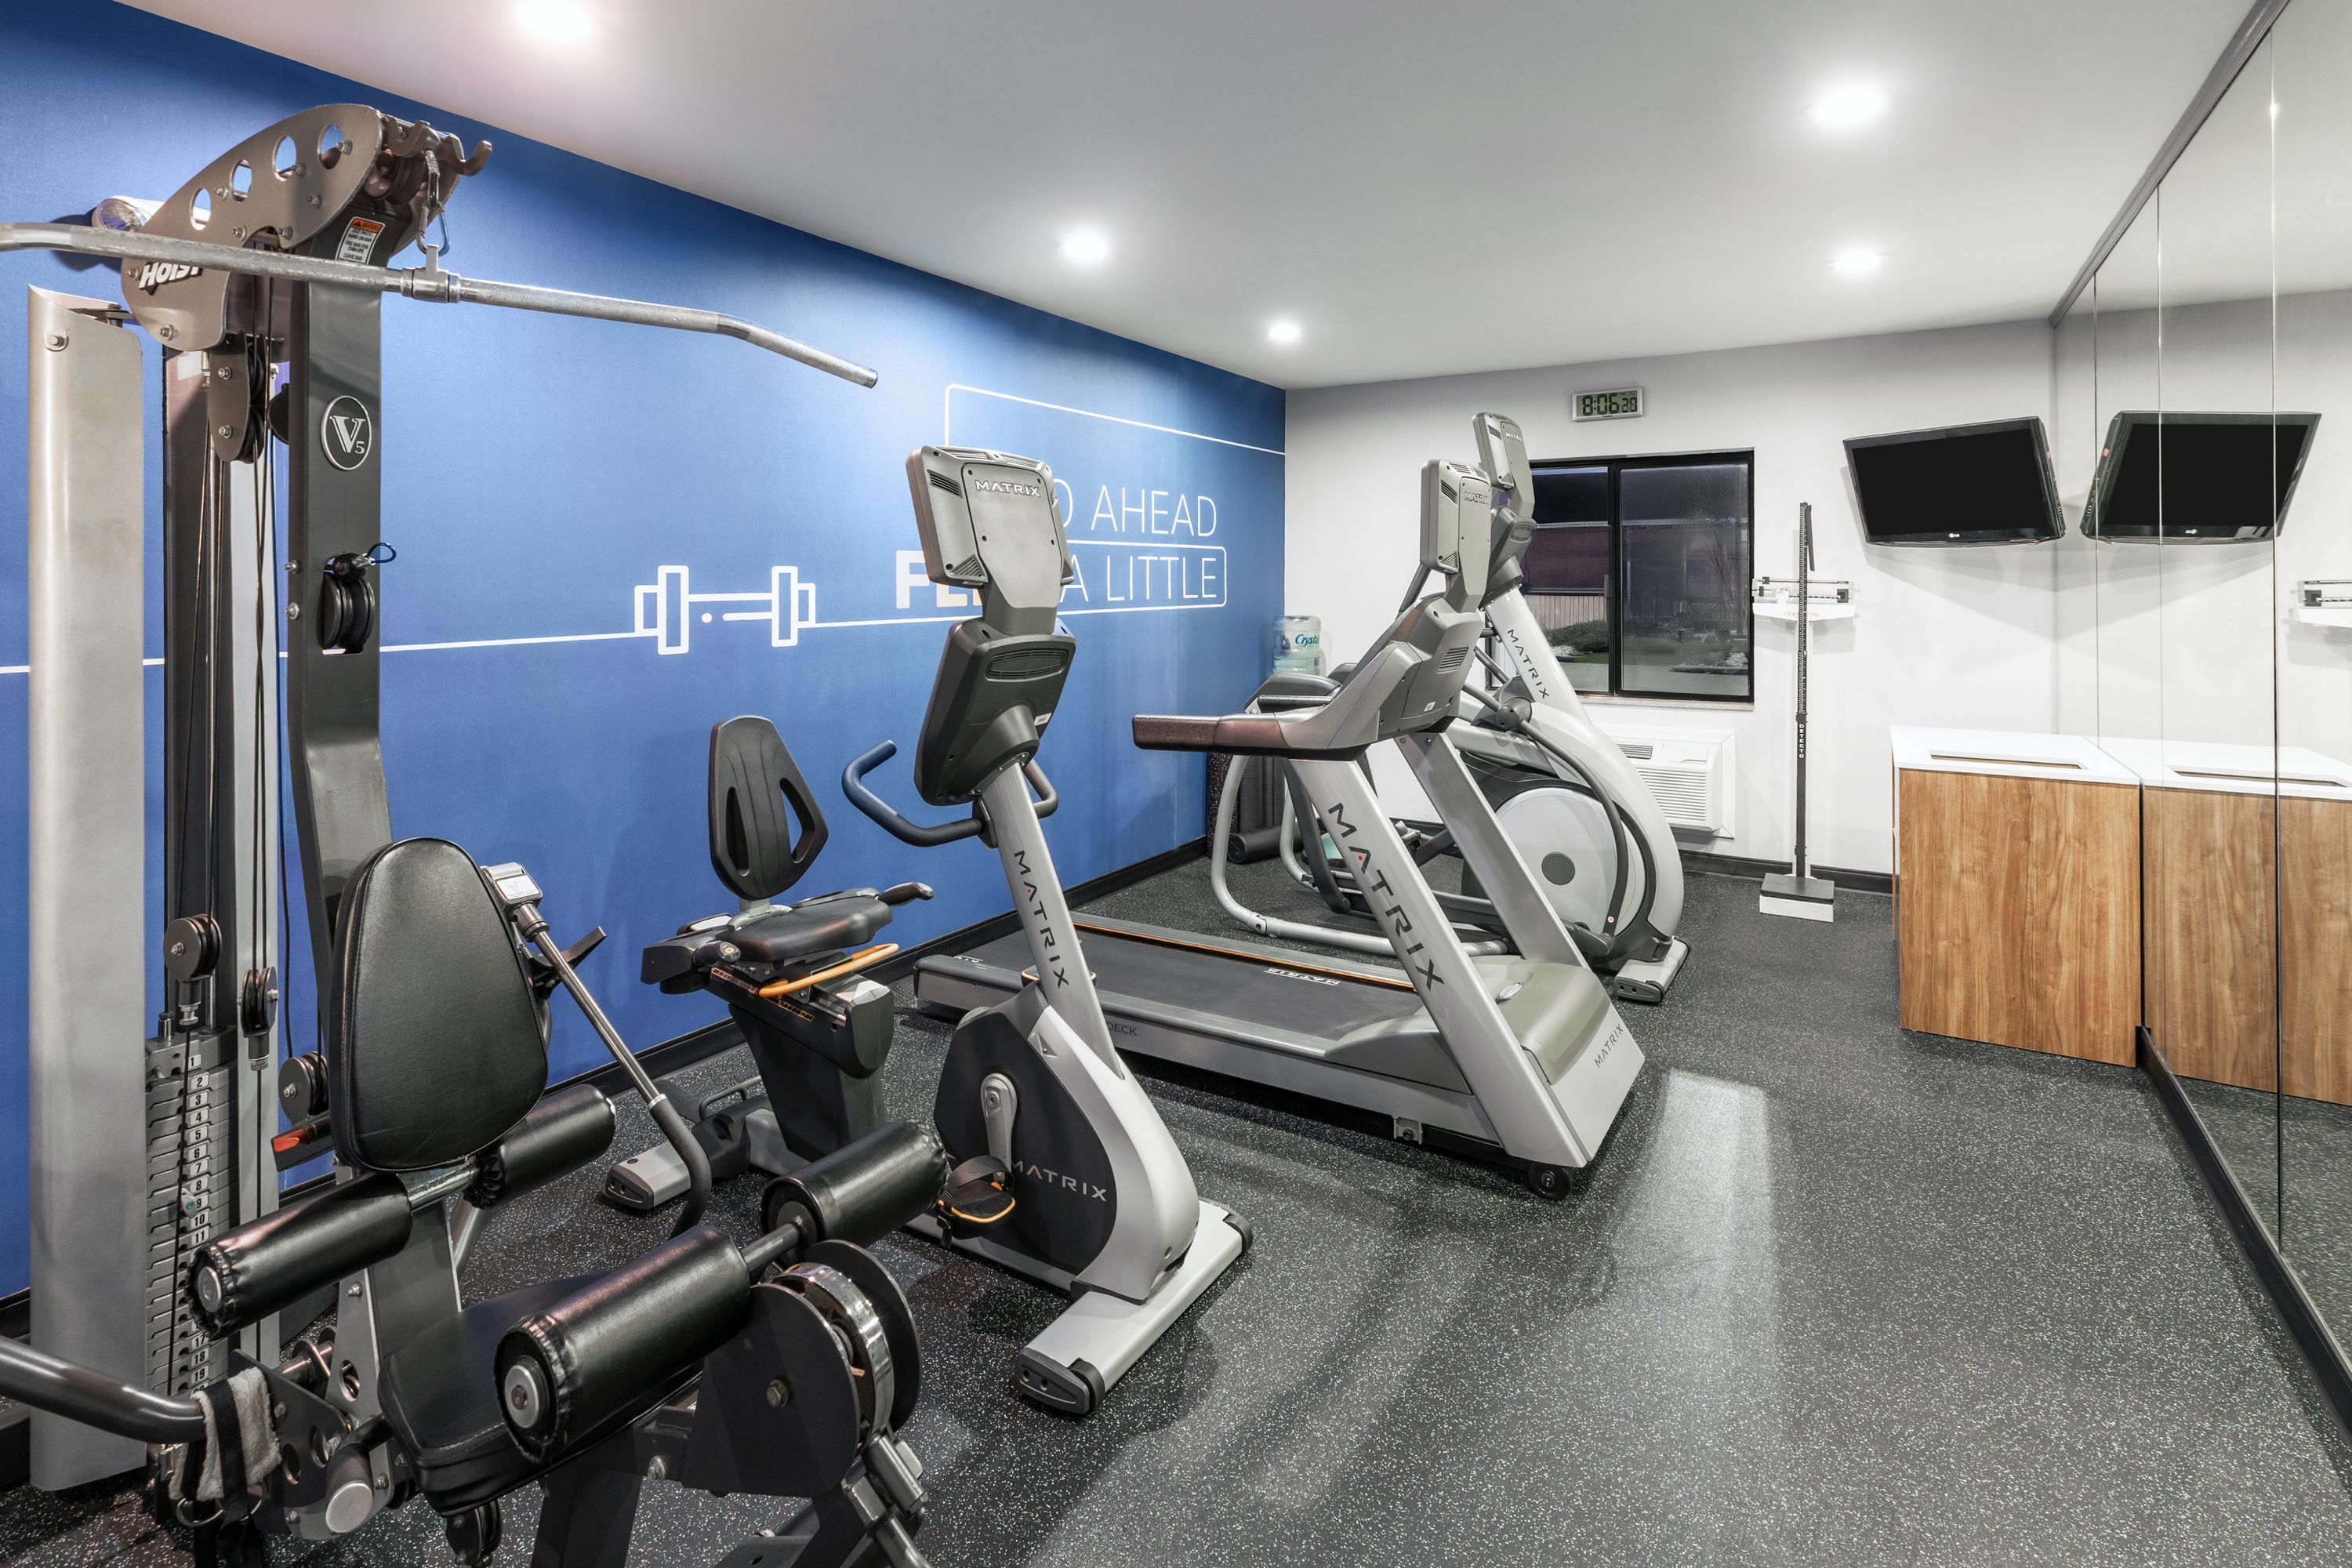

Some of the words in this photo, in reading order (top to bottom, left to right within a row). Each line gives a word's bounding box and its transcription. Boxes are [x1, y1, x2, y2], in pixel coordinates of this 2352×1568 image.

[1582, 392, 1620, 416] 8:06
[975, 479, 1040, 497] MATRIX
[1091, 485, 1217, 537] AHEAD
[1106, 555, 1217, 601] LITTLE
[1507, 629, 1549, 699] MATRIX
[1327, 802, 1446, 992] MATRIX
[1014, 850, 1069, 989] MATRIX
[1594, 1023, 1624, 1069] MATRIX
[197, 1077, 203, 1087] 2
[195, 1094, 201, 1105] 3
[196, 1112, 202, 1122] 4
[195, 1130, 201, 1140] 5
[194, 1148, 200, 1159] 6
[195, 1163, 201, 1174] 7
[196, 1180, 202, 1191] 8
[1011, 1160, 1107, 1202] MATRIX
[196, 1198, 201, 1208] 9
[194, 1214, 205, 1226] 10
[194, 1231, 205, 1243] 11
[194, 1351, 205, 1364] 18
[194, 1368, 205, 1381] 19
